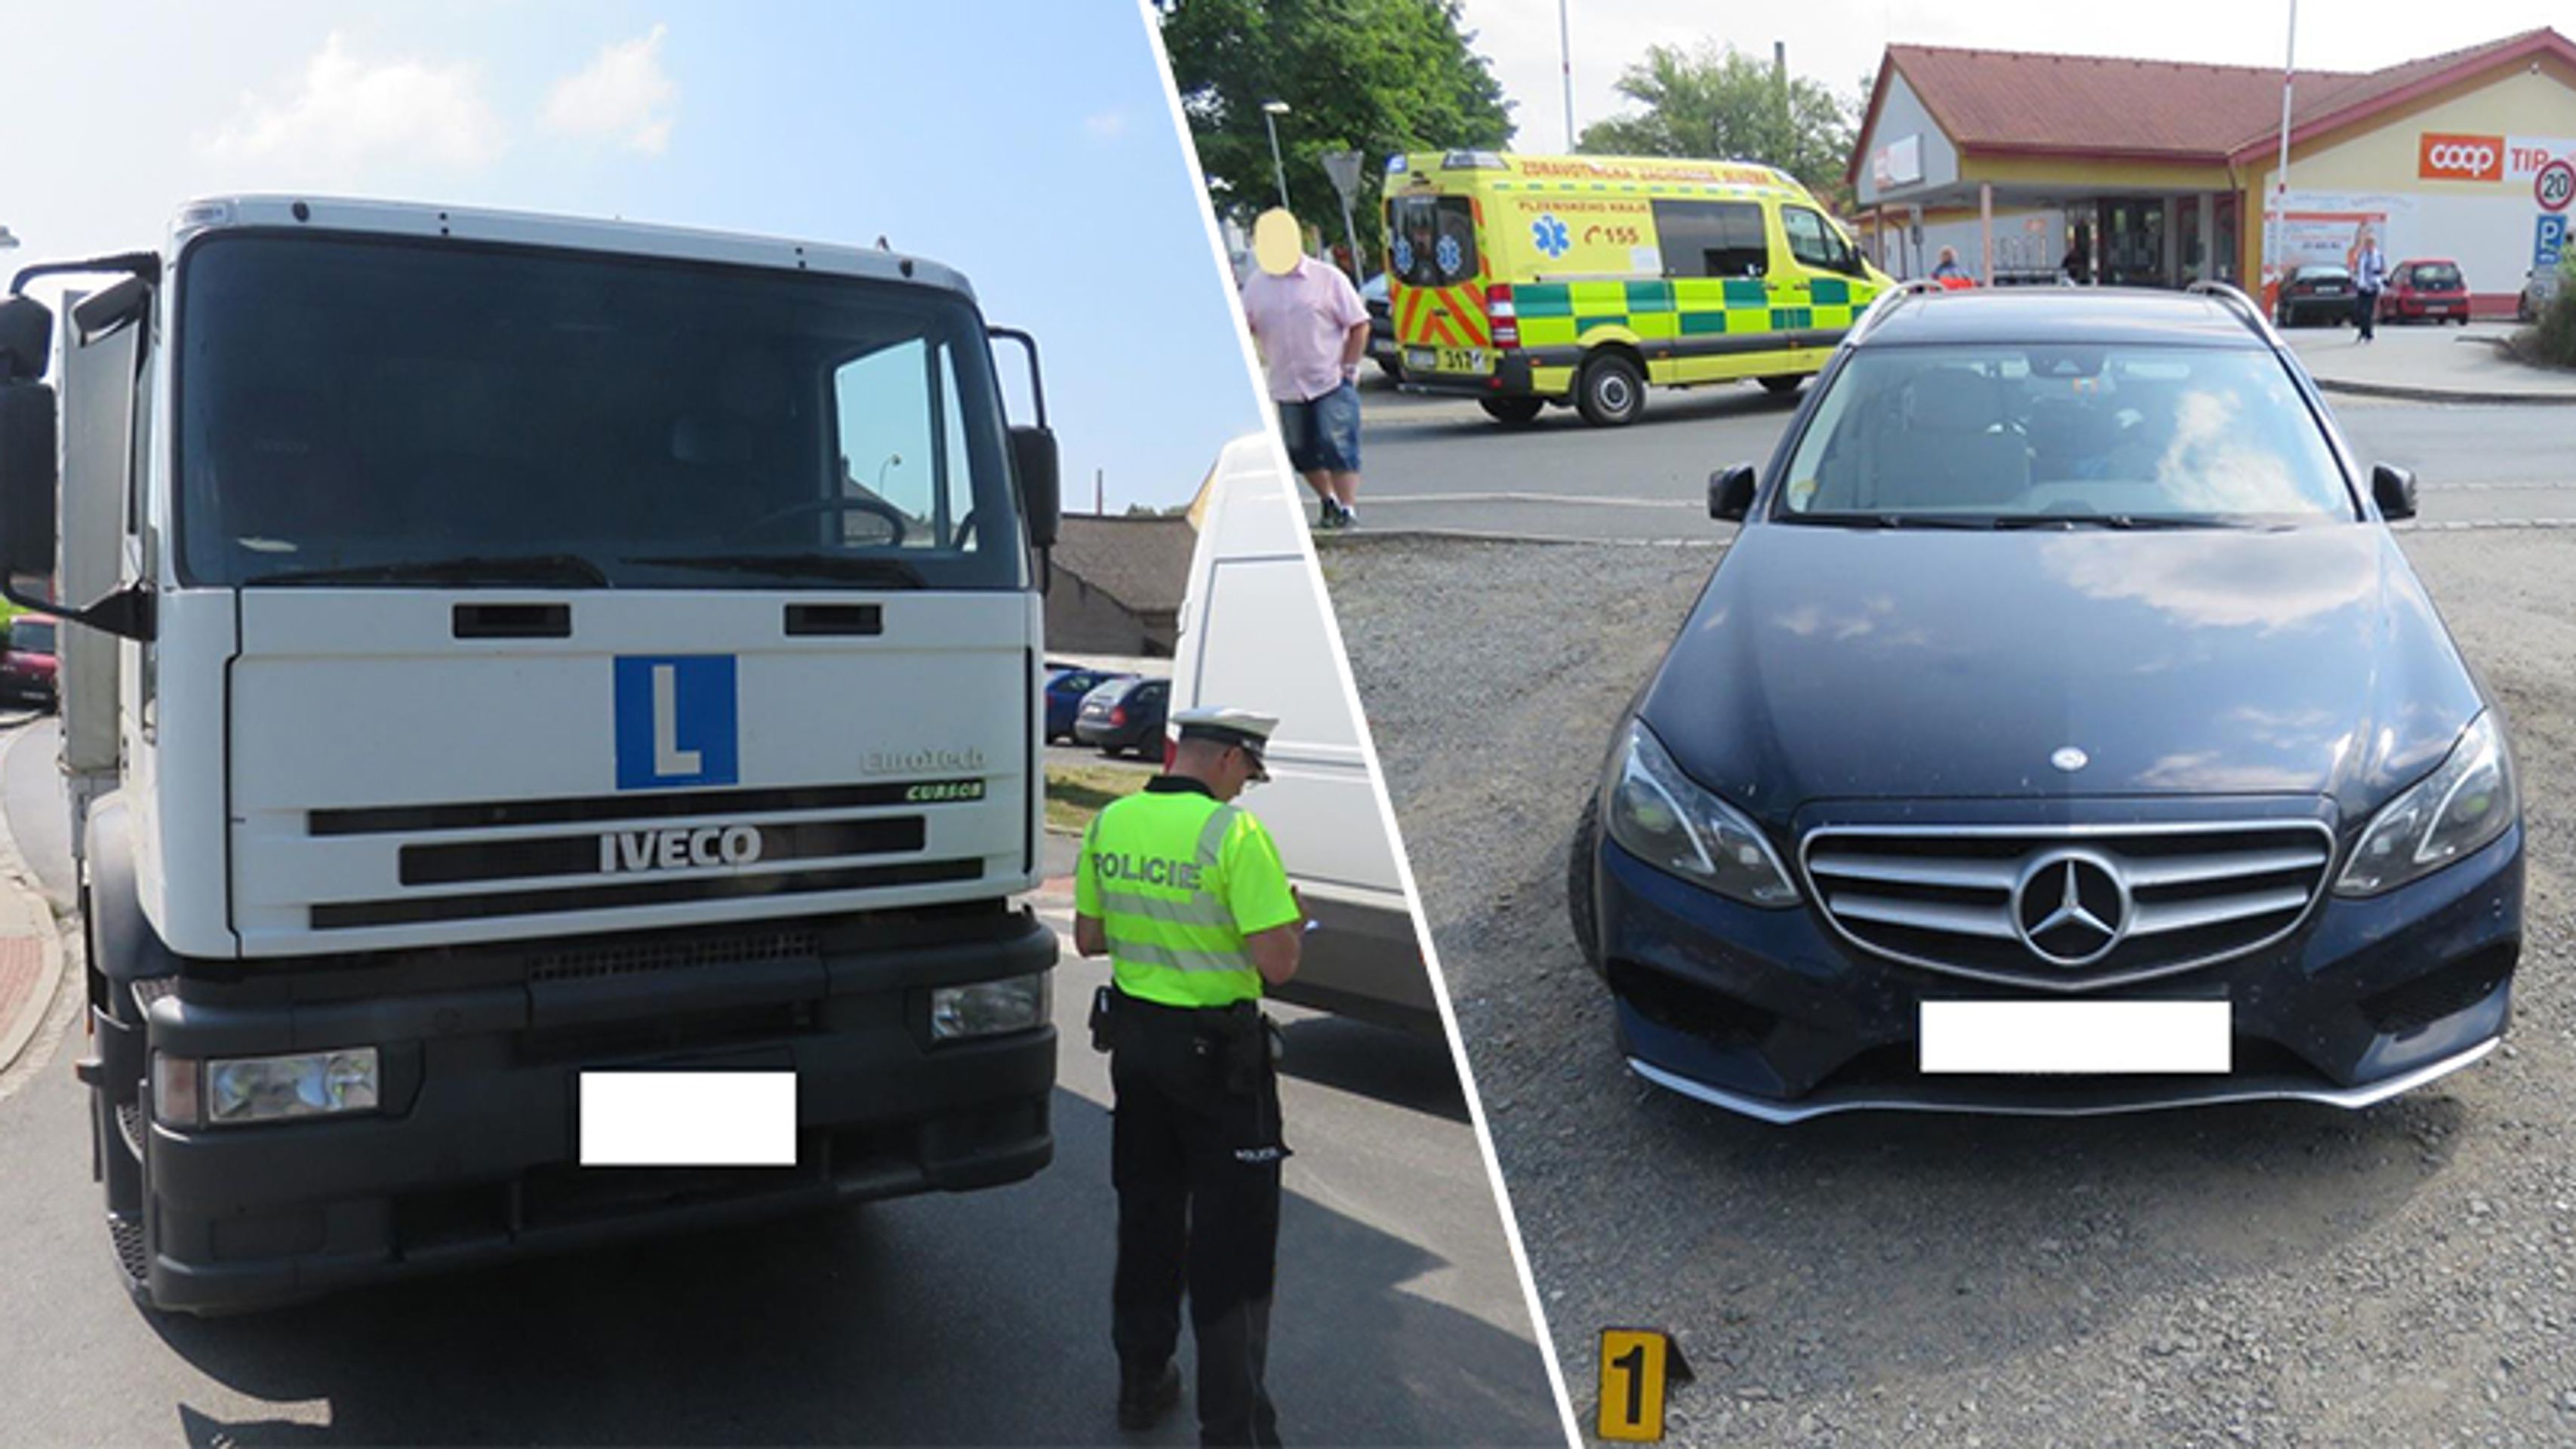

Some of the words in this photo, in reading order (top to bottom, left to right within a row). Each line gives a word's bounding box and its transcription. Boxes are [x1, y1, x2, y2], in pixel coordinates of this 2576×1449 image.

[2429, 143, 2494, 177] coop
[2510, 148, 2550, 172] TIP
[2544, 174, 2568, 198] 20
[1605, 226, 1639, 245] 155
[653, 665, 700, 776] L
[907, 783, 981, 800] CURSOR
[600, 826, 762, 873] IVECO
[1092, 853, 1202, 890] POLICIE
[1612, 1345, 1644, 1425] 1
